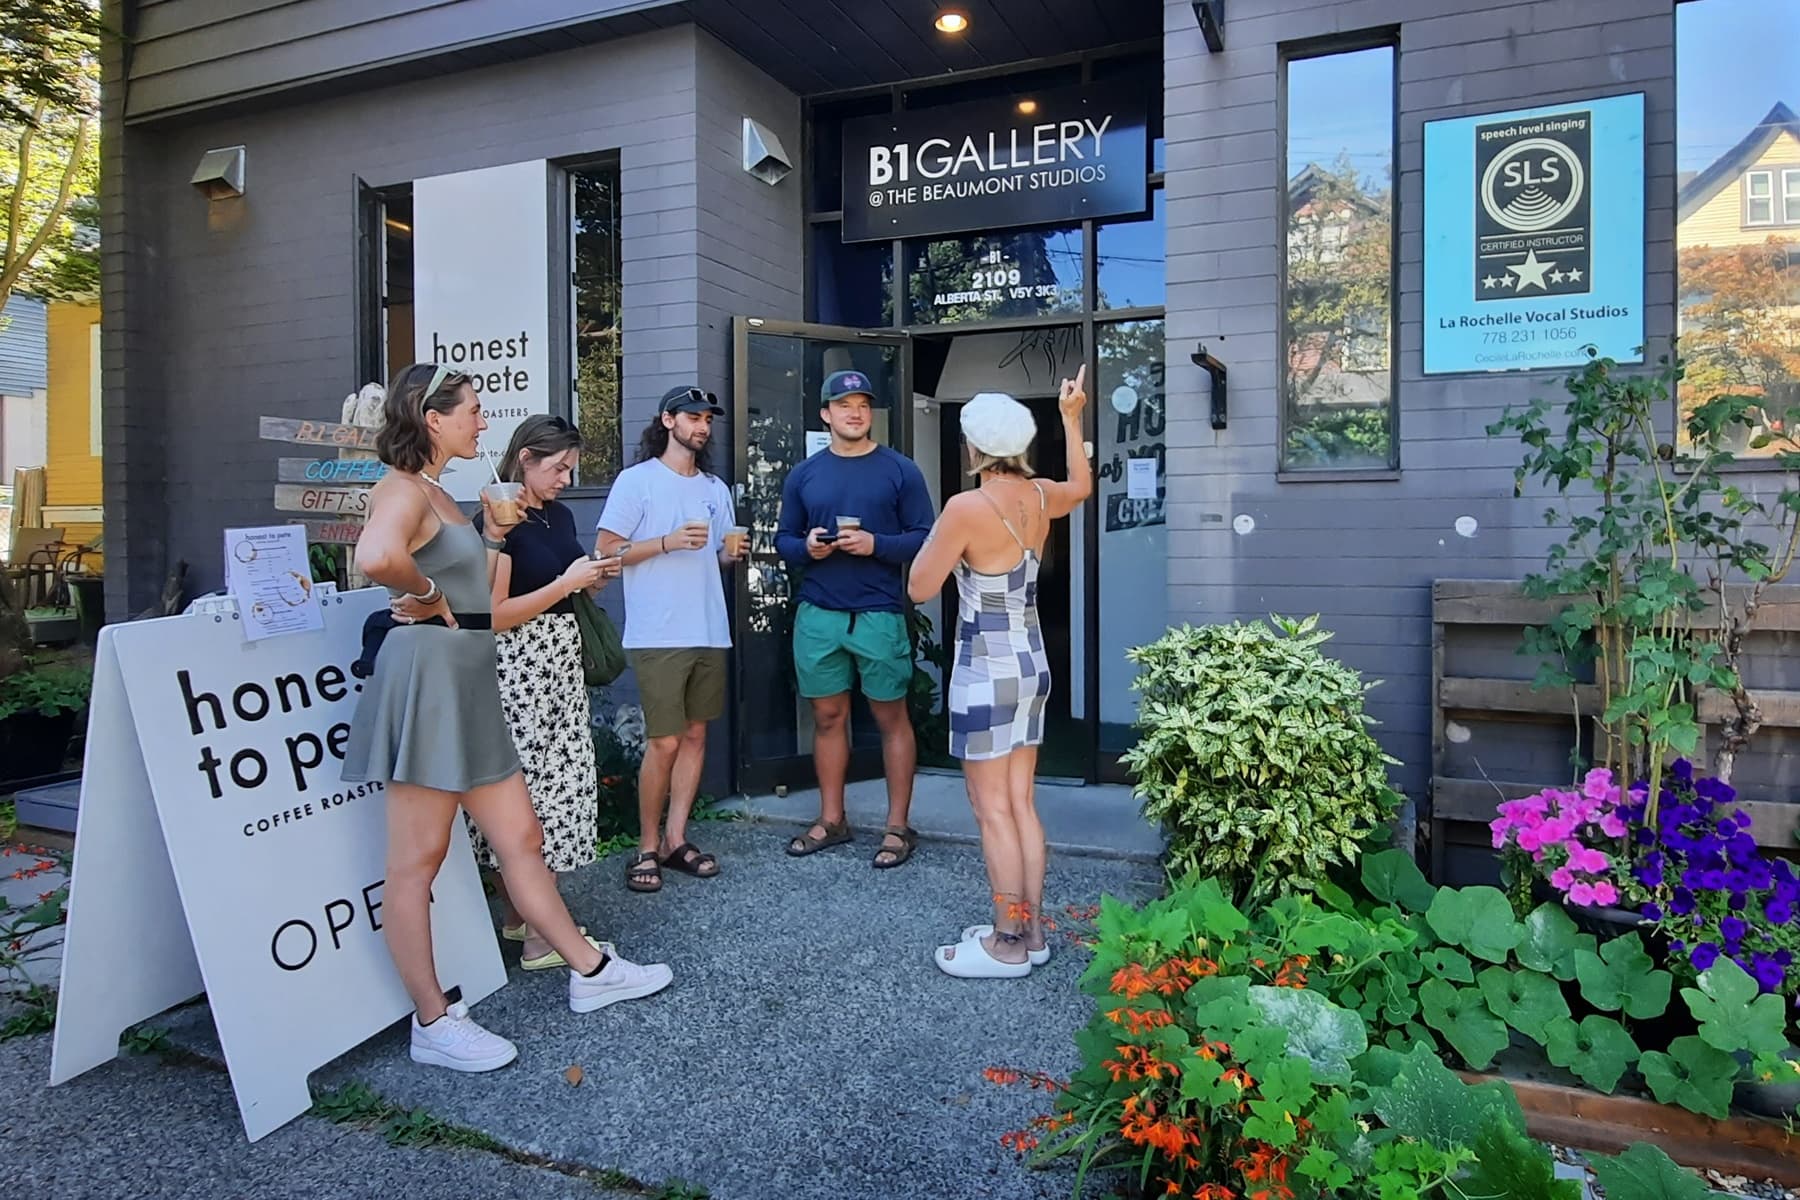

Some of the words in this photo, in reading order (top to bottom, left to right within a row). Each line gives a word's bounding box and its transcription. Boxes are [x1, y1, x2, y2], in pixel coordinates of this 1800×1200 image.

[1481, 127, 1517, 141] speech
[1519, 124, 1544, 136] level
[1546, 119, 1586, 131] singing
[916, 115, 1112, 178] GALLERY
[869, 191, 884, 207] @
[887, 187, 917, 205] THE
[923, 174, 1023, 201] BEAUMONT
[1030, 164, 1106, 189] STUDIOS
[1503, 157, 1560, 187] SLS
[1480, 239, 1525, 252] CERTIFIED
[1526, 234, 1584, 247] INSTRUCTOR
[972, 269, 1021, 289] 2109
[934, 292, 980, 305] ALBERTA
[1009, 286, 1034, 299] V5Y
[1035, 284, 1058, 297] 3K3
[1439, 317, 1456, 329] La
[1460, 310, 1522, 327] Rochelle
[1525, 308, 1566, 324] Vocal
[1570, 305, 1629, 321] Studios
[433, 331, 529, 363] honest
[483, 408, 529, 418] OASTERS
[320, 523, 365, 540] ENTR
[198, 746, 268, 799] to
[284, 722, 351, 792] pe
[243, 803, 314, 837] COFFEE
[321, 781, 384, 810] ROASTE
[271, 879, 434, 971] OPE
